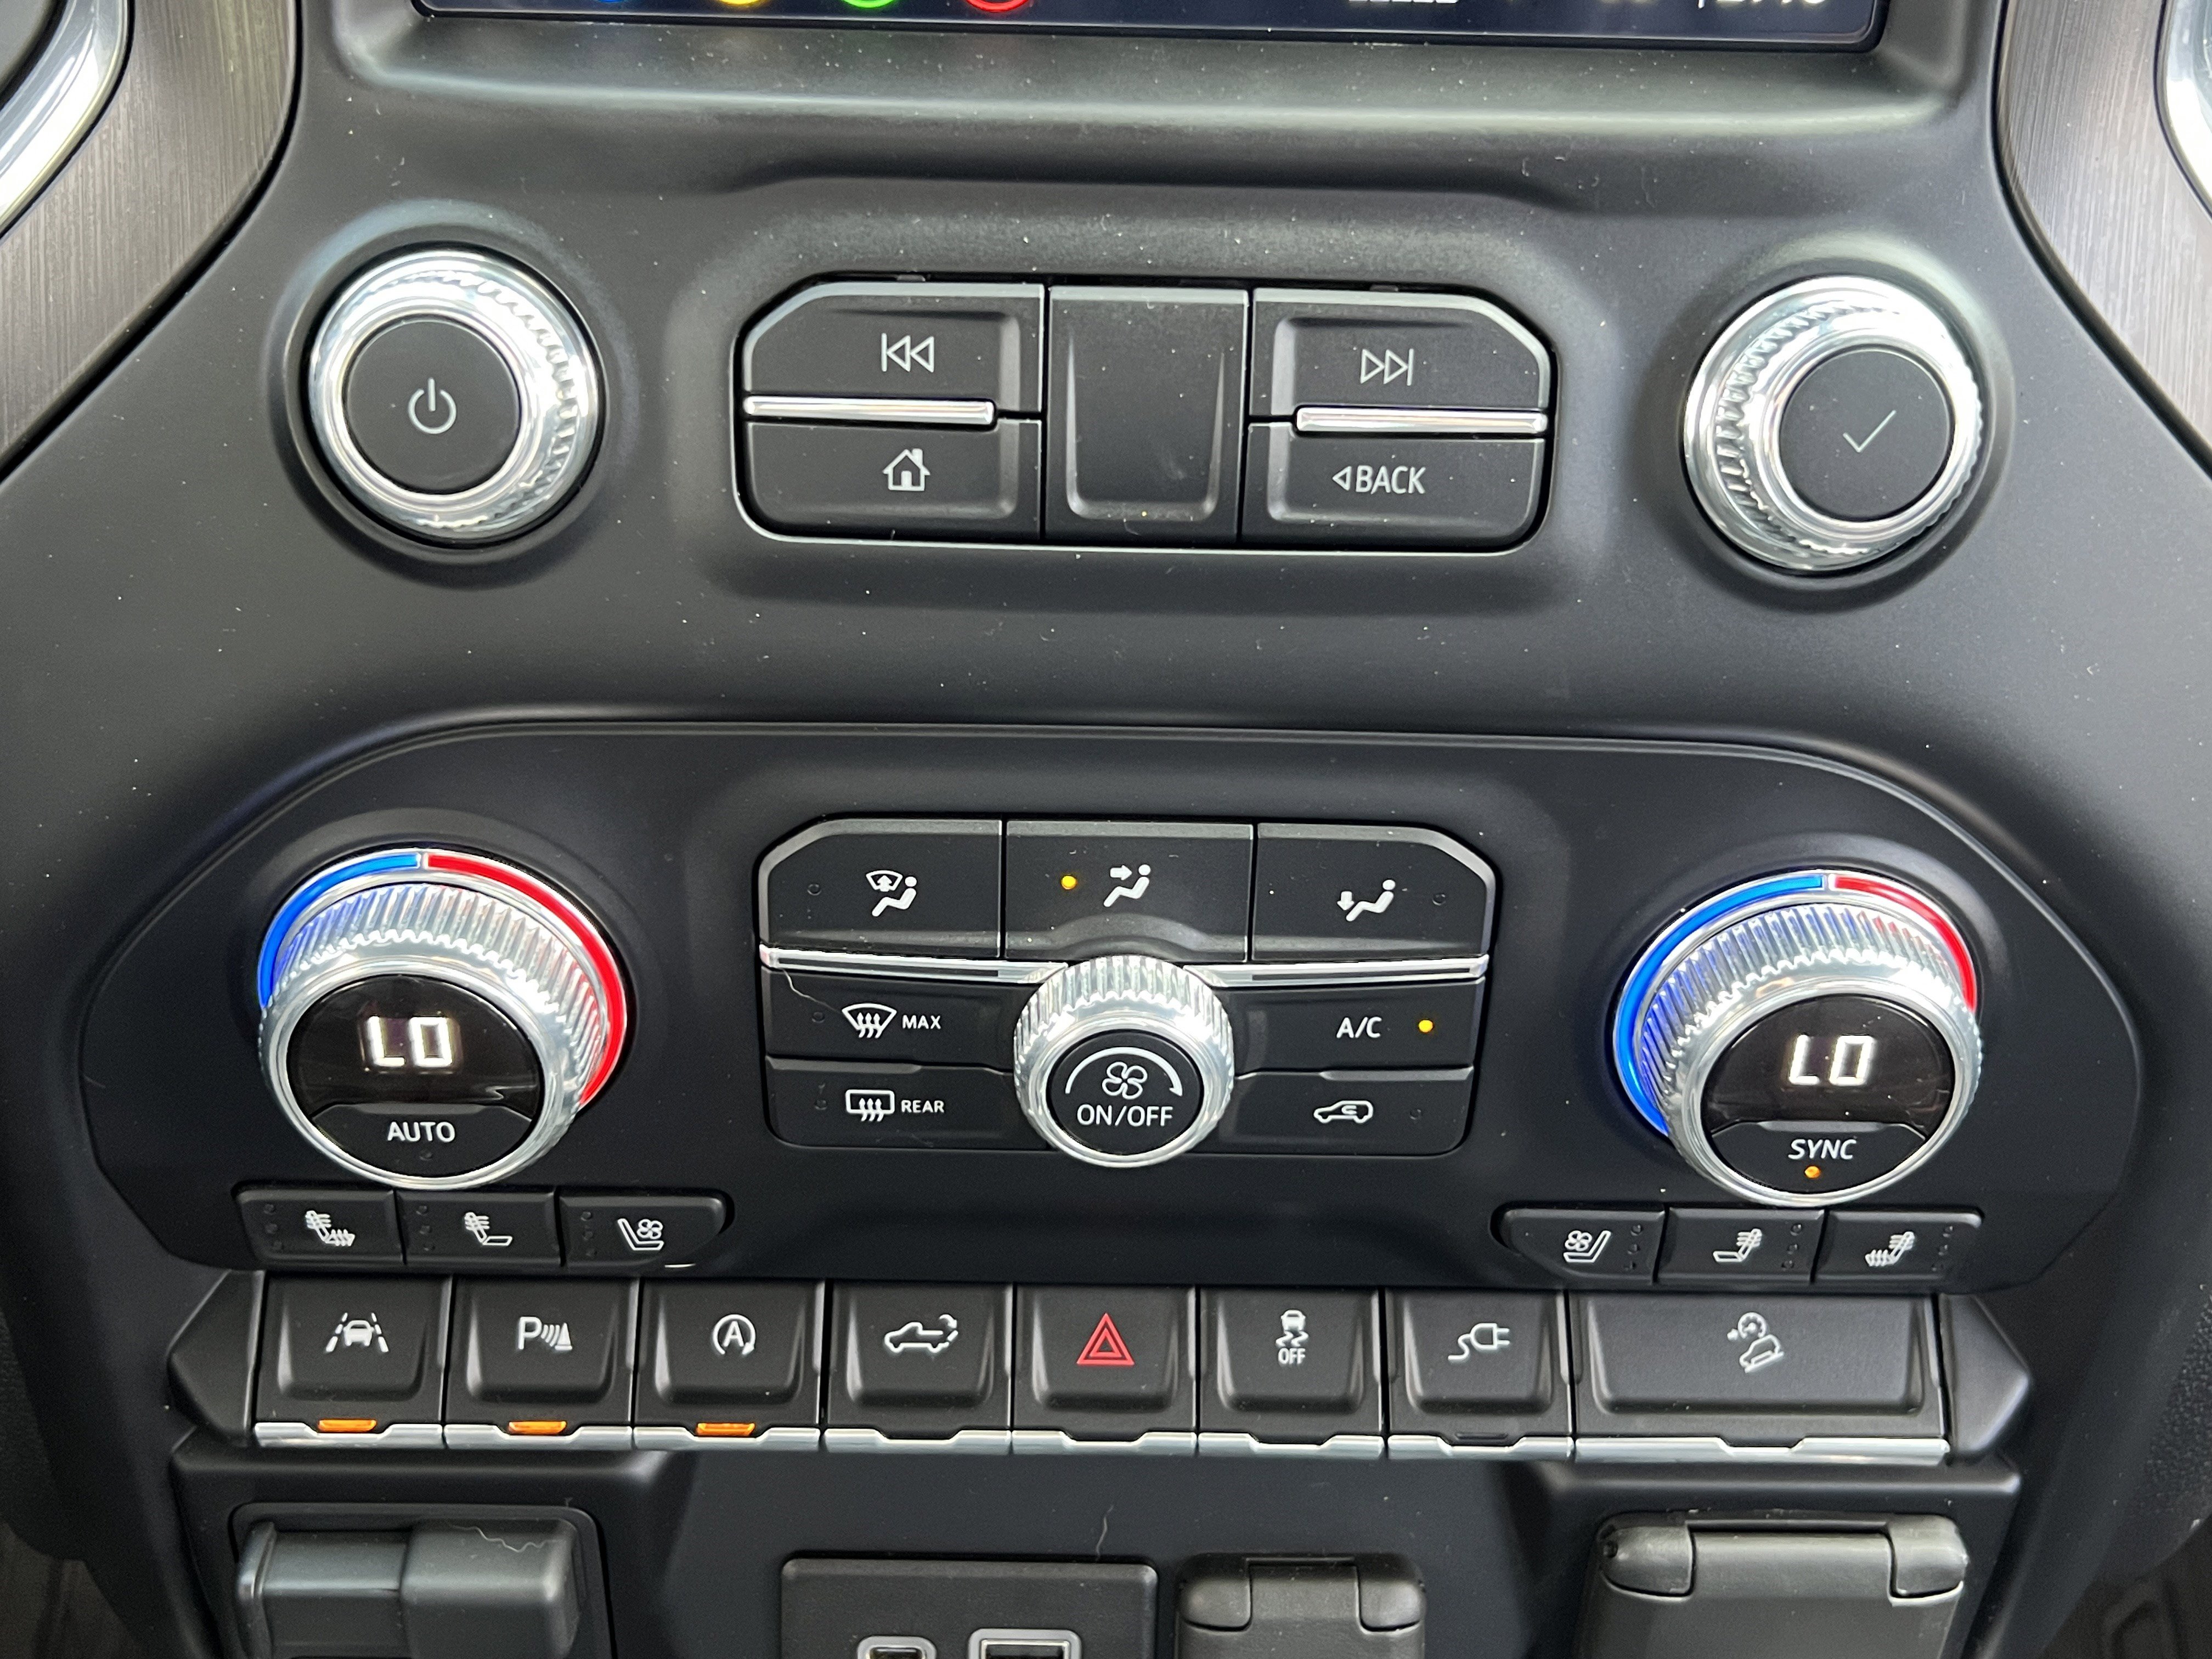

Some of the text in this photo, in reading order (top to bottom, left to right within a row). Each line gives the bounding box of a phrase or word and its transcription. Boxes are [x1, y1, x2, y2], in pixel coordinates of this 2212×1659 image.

[1356, 465, 1426, 494] BACK
[902, 1014, 941, 1030] MAX
[1336, 1017, 1382, 1039] A/C
[368, 1016, 453, 1068] LO
[1788, 1035, 1875, 1086] LO
[901, 1099, 945, 1114] REAR
[1077, 1104, 1173, 1127] ON/OFF
[387, 1122, 455, 1143] AUTO
[1788, 1139, 1857, 1160] SYNC
[1278, 1347, 1306, 1365] OFF
